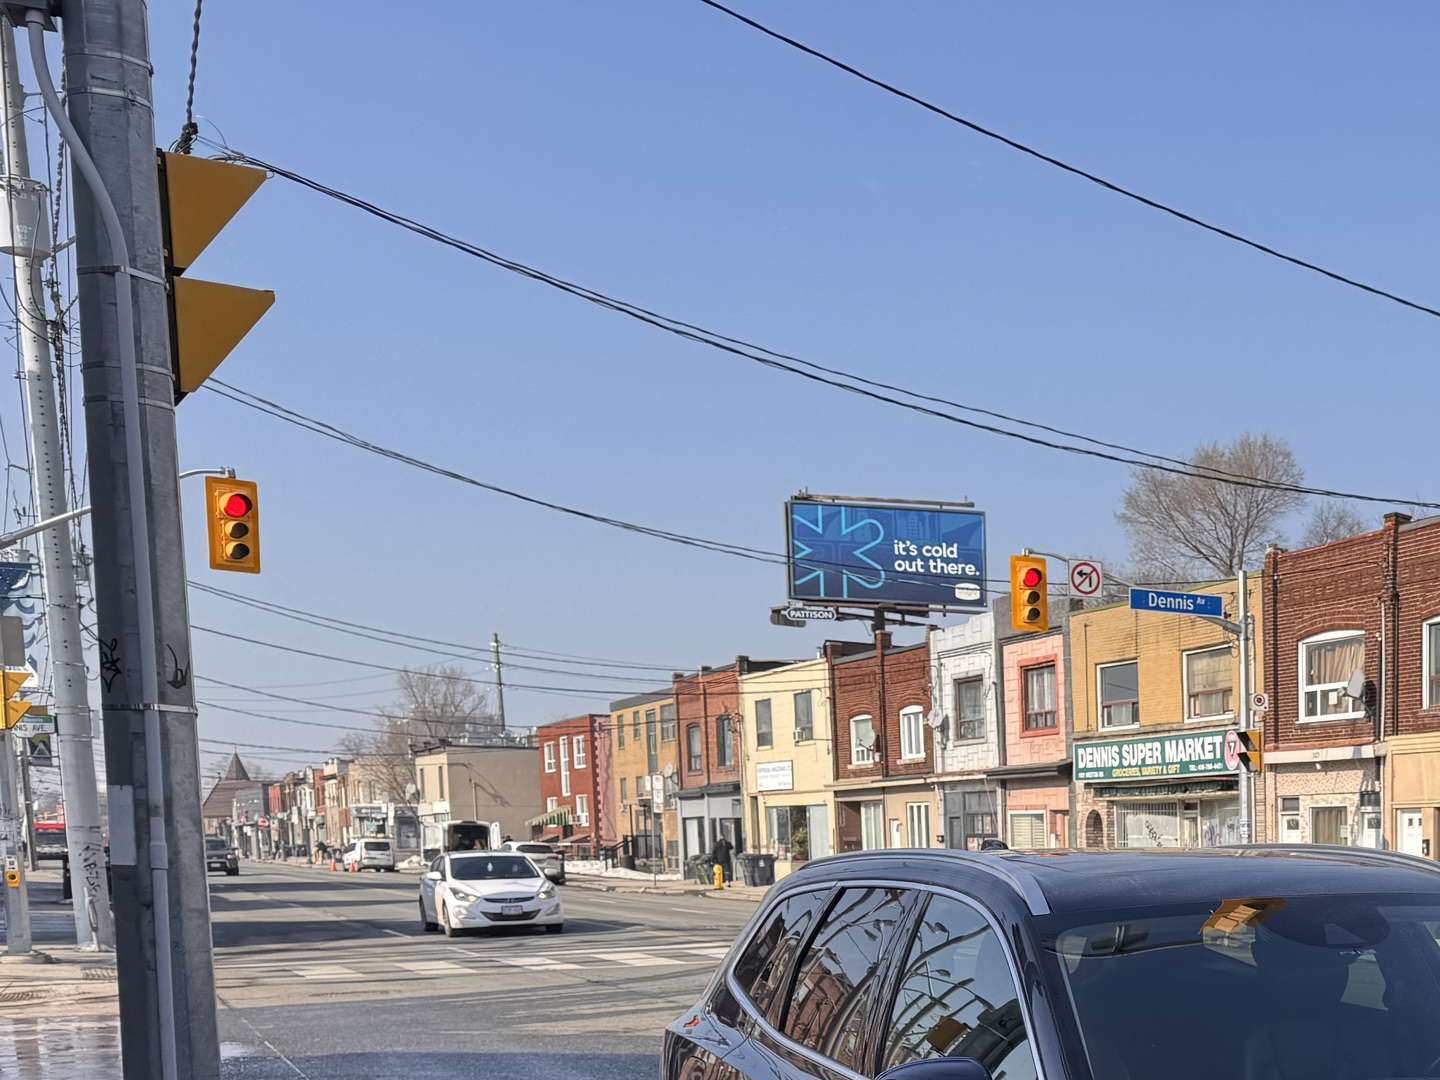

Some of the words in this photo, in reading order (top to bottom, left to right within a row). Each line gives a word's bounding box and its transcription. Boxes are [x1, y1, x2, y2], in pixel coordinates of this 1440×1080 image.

[894, 540, 918, 556] it's
[922, 542, 958, 559] cold
[894, 559, 924, 573] out
[929, 560, 980, 576] there.
[1148, 592, 1194, 610] Dennis
[790, 610, 833, 619] PATTISON
[1078, 745, 1120, 769] DENNIS
[1121, 741, 1161, 766] SUPER
[1164, 735, 1223, 763] MARKET
[1168, 764, 1180, 774] GIFT
